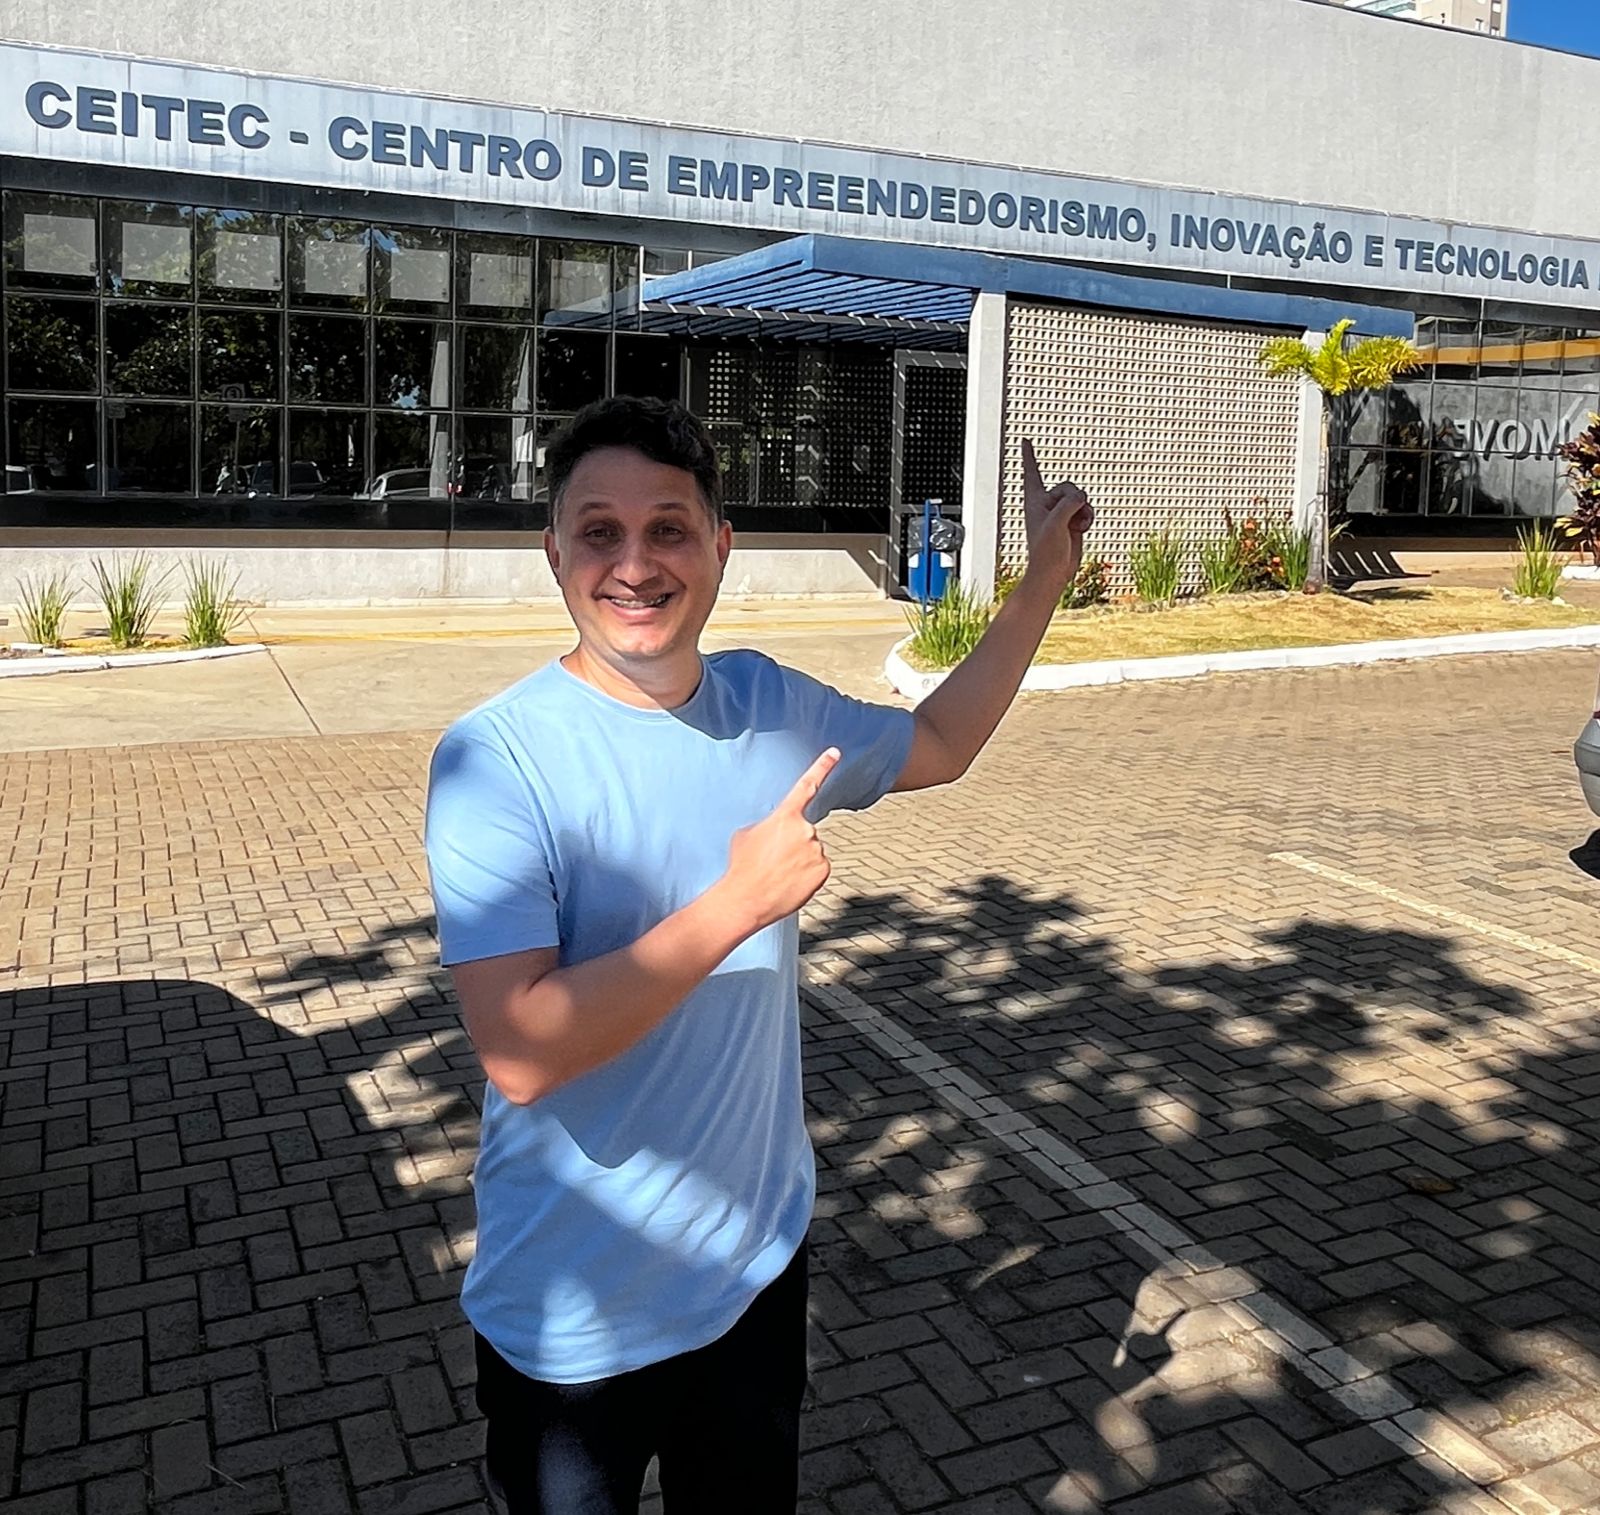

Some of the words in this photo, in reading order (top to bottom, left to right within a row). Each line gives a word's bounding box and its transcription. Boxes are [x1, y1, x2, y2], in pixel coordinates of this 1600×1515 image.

[25, 81, 271, 149] CEITEC
[328, 116, 562, 182] CENTRO
[581, 146, 649, 192] DE
[667, 155, 1157, 253] EMPREENDEDORISMO,
[1170, 213, 1353, 269] INOVAÇÃO
[1363, 234, 1384, 268] E
[1394, 238, 1590, 290] TECNOLOGIA
